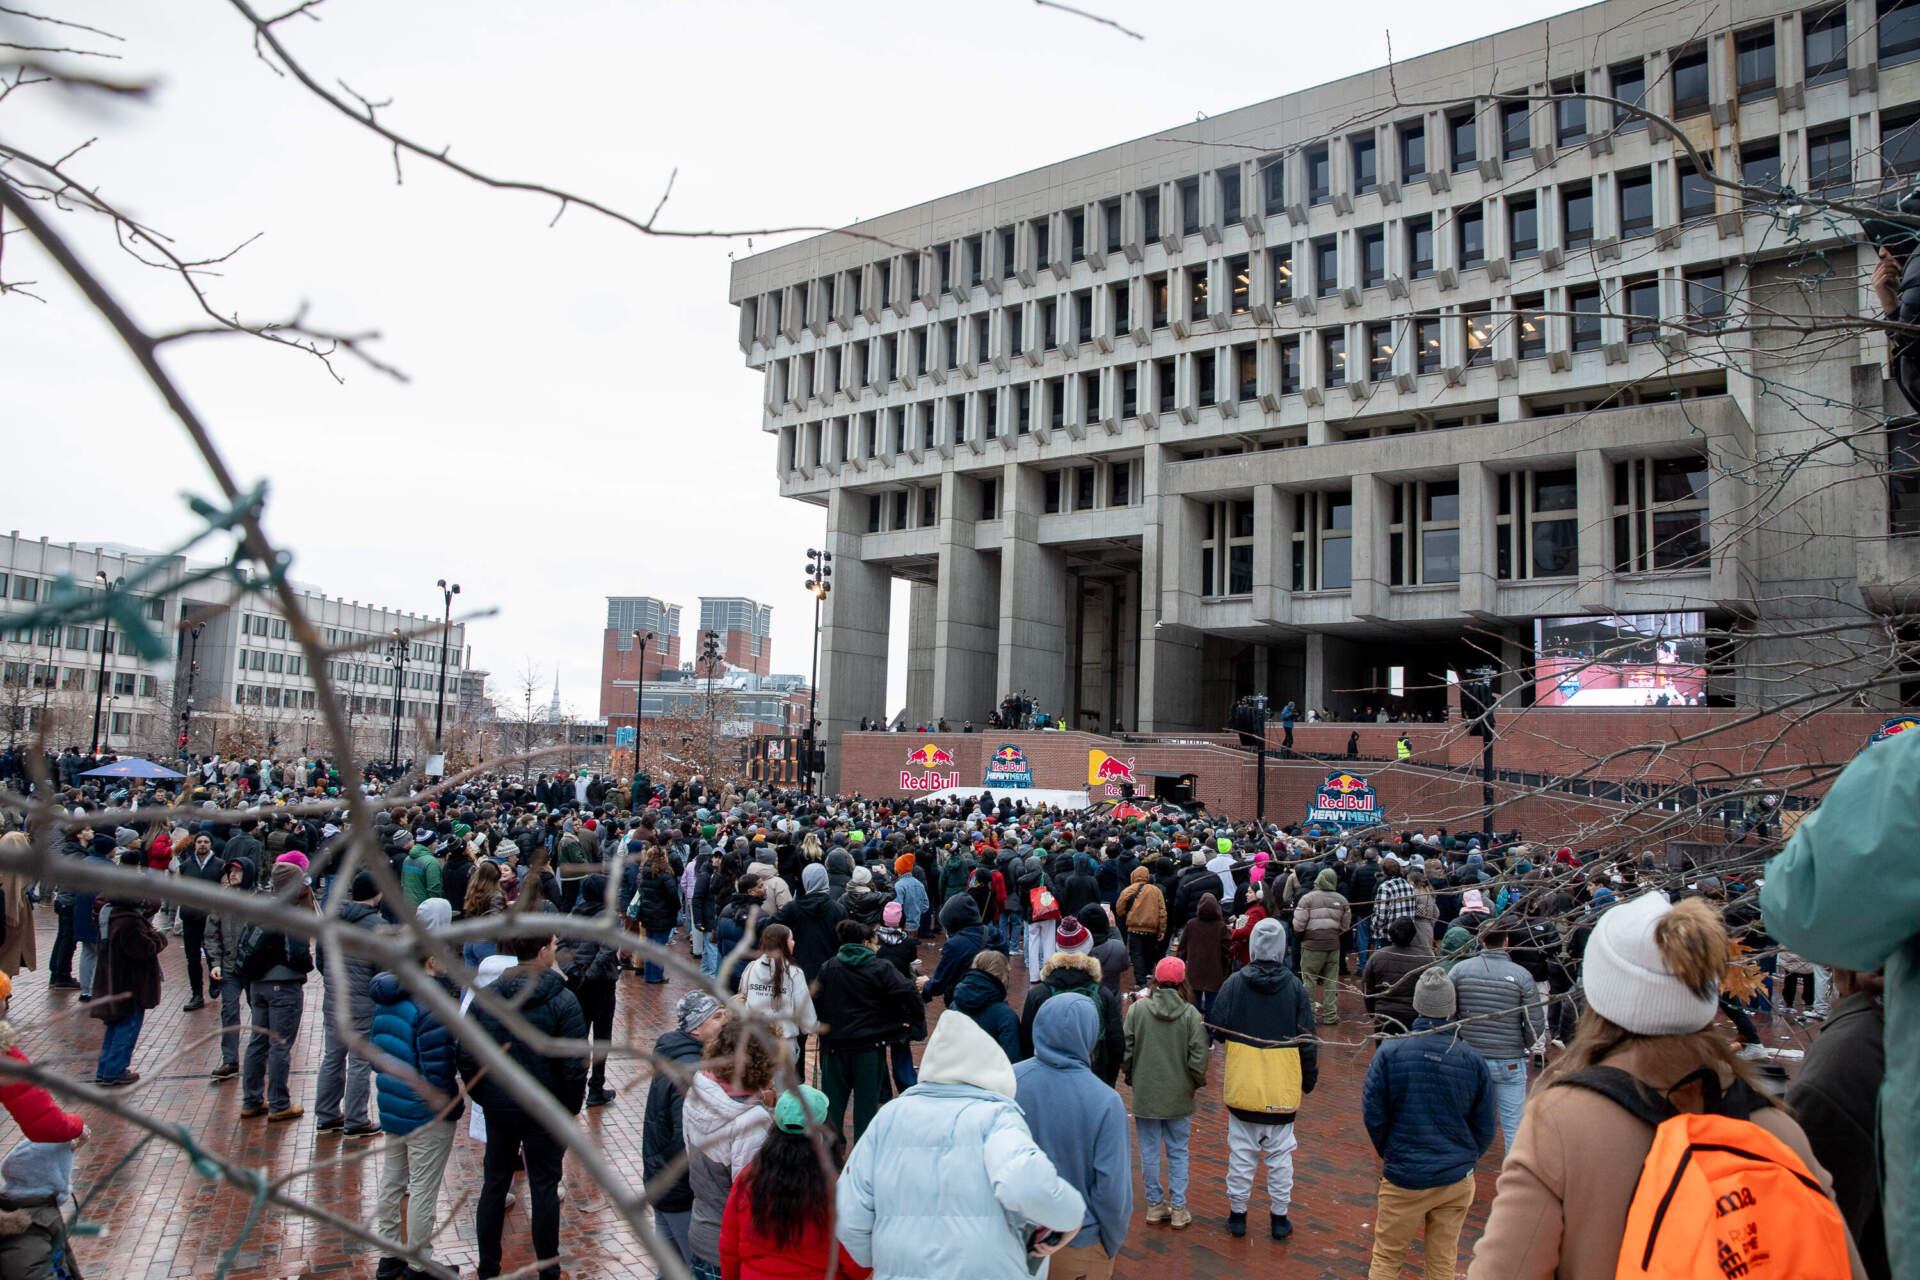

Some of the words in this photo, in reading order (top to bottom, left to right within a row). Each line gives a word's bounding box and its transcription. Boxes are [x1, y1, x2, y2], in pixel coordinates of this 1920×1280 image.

[992, 761, 1009, 772] Red
[1009, 761, 1026, 773] Bull
[900, 771, 929, 789] Red
[930, 771, 959, 790] Bull
[1105, 784, 1122, 796] Re
[1318, 794, 1345, 809] Red
[1346, 795, 1374, 811] Bull
[1309, 808, 1346, 821] HEAVY
